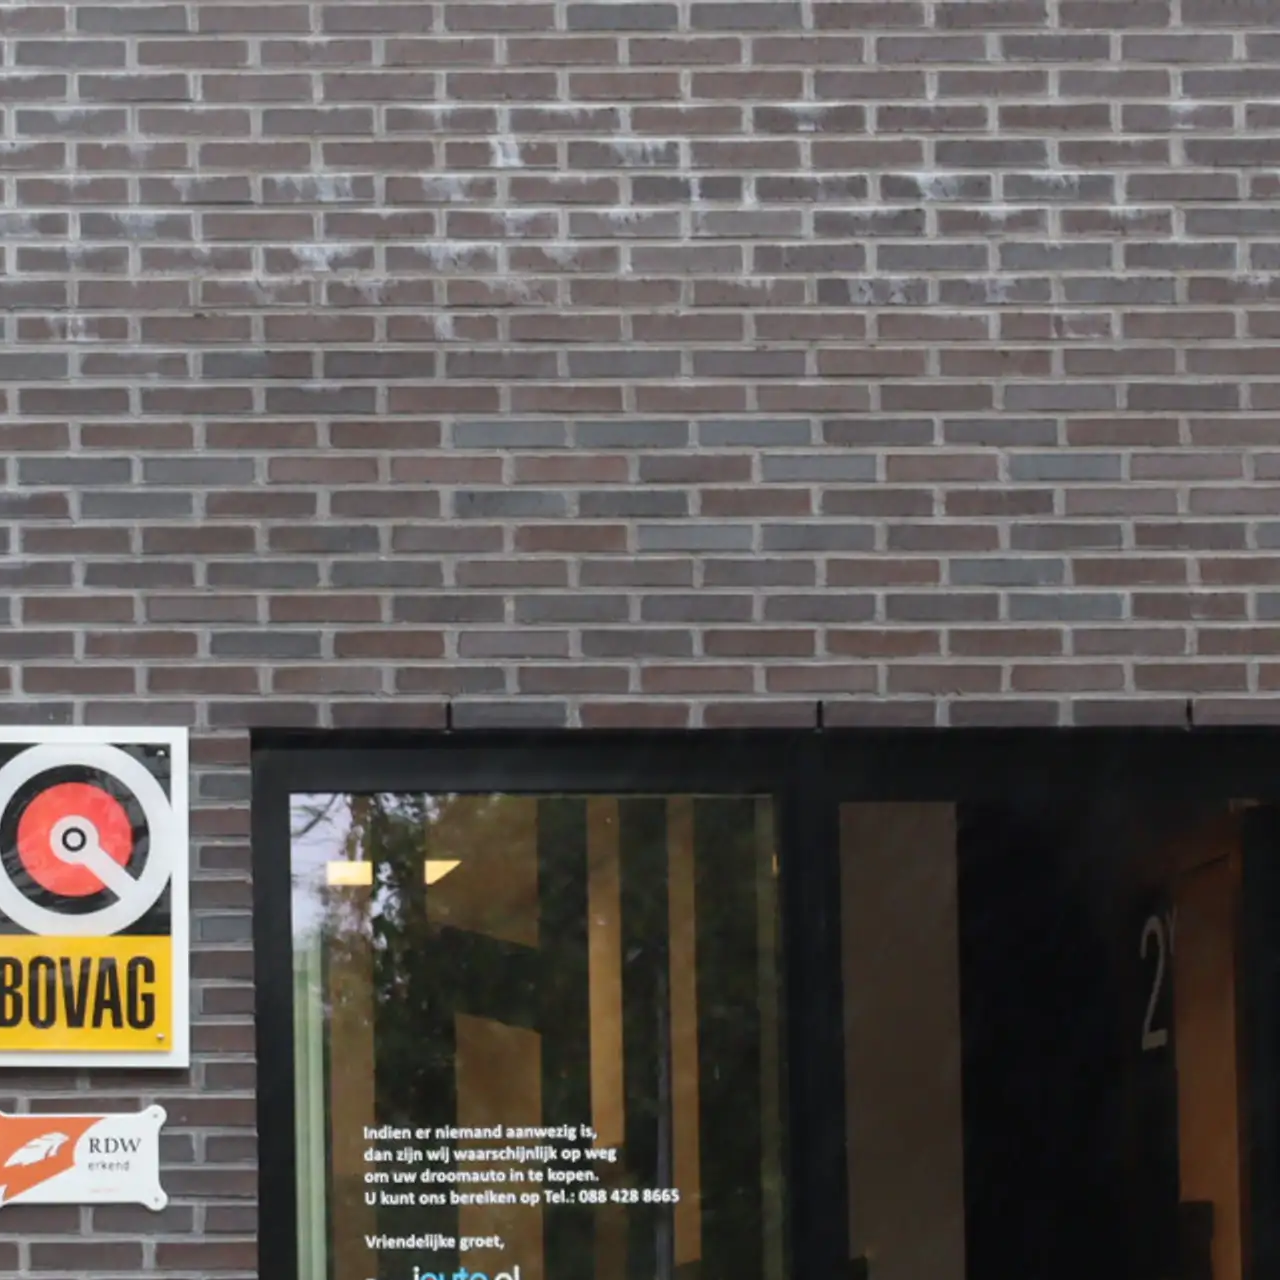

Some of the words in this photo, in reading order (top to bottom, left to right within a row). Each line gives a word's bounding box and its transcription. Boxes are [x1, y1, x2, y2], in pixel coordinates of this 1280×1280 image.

[363, 1126, 411, 1139] Indien
[415, 1128, 431, 1139] er
[435, 1125, 502, 1139] niemand
[506, 1124, 577, 1141] aanwezig
[580, 1124, 597, 1139] is,
[88, 1137, 142, 1154] RDW
[364, 1148, 392, 1161] dan
[396, 1147, 423, 1164] zijn
[426, 1147, 450, 1164] wij
[453, 1146, 557, 1163] waarschijnlijk
[561, 1148, 581, 1162] op
[584, 1147, 617, 1162] weg
[88, 1160, 130, 1172] erkend
[364, 1171, 389, 1183] om
[393, 1171, 416, 1183] uw
[420, 1169, 506, 1183] droomauto
[510, 1169, 524, 1182] in
[528, 1169, 543, 1181] te
[547, 1168, 599, 1184] kopen.
[365, 1191, 376, 1205] U
[380, 1190, 415, 1205] kunt
[419, 1192, 446, 1205] ons
[450, 1190, 516, 1204] bereiken
[520, 1191, 540, 1206] op
[544, 1190, 575, 1203] Tel.:
[578, 1190, 607, 1203] 088
[610, 1189, 639, 1203] 428
[643, 1188, 680, 1203] 8665
[365, 1234, 456, 1251] Vriendelijke
[459, 1235, 505, 1251] groet,
